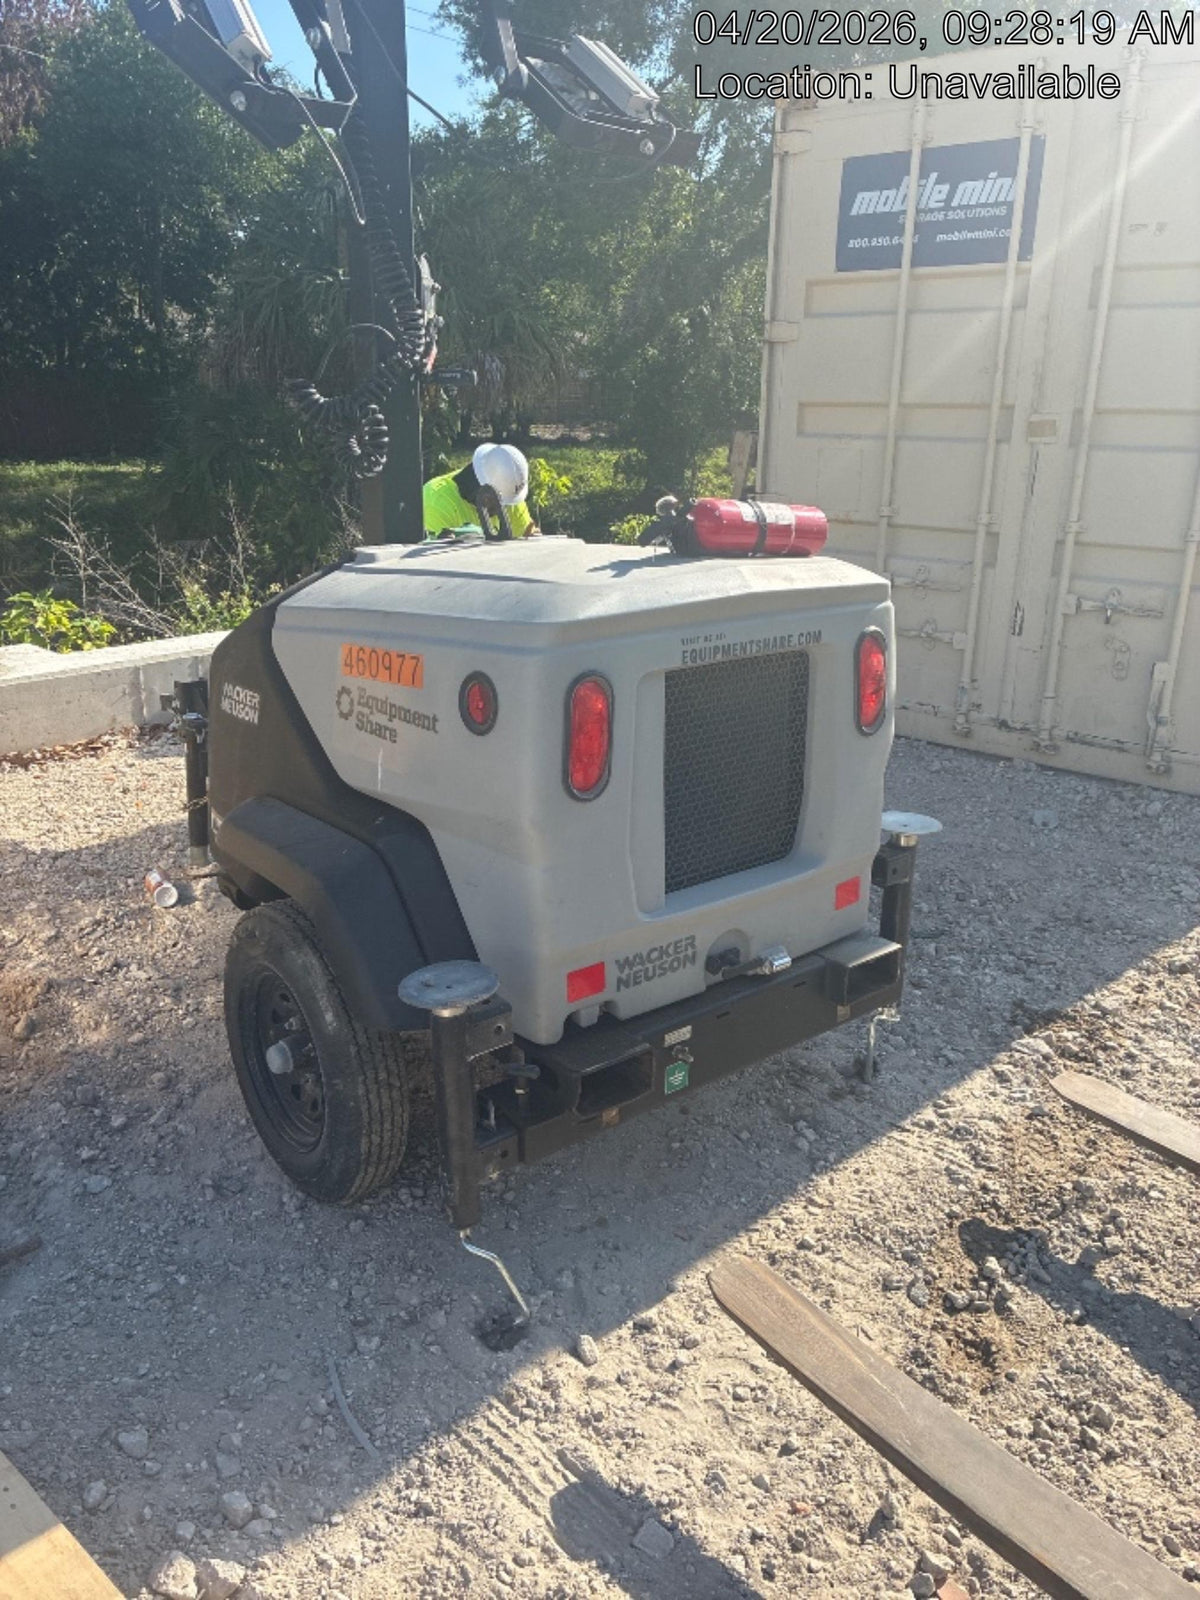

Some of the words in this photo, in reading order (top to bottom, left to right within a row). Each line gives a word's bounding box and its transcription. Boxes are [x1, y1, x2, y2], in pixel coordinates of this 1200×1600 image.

[343, 646, 421, 686] 460977
[682, 630, 822, 664] EQUIPMENTSHARE.COM
[355, 710, 398, 743] Share
[357, 686, 439, 734] Equipment
[615, 934, 696, 974] WACKER
[616, 951, 696, 992] NEUSON
